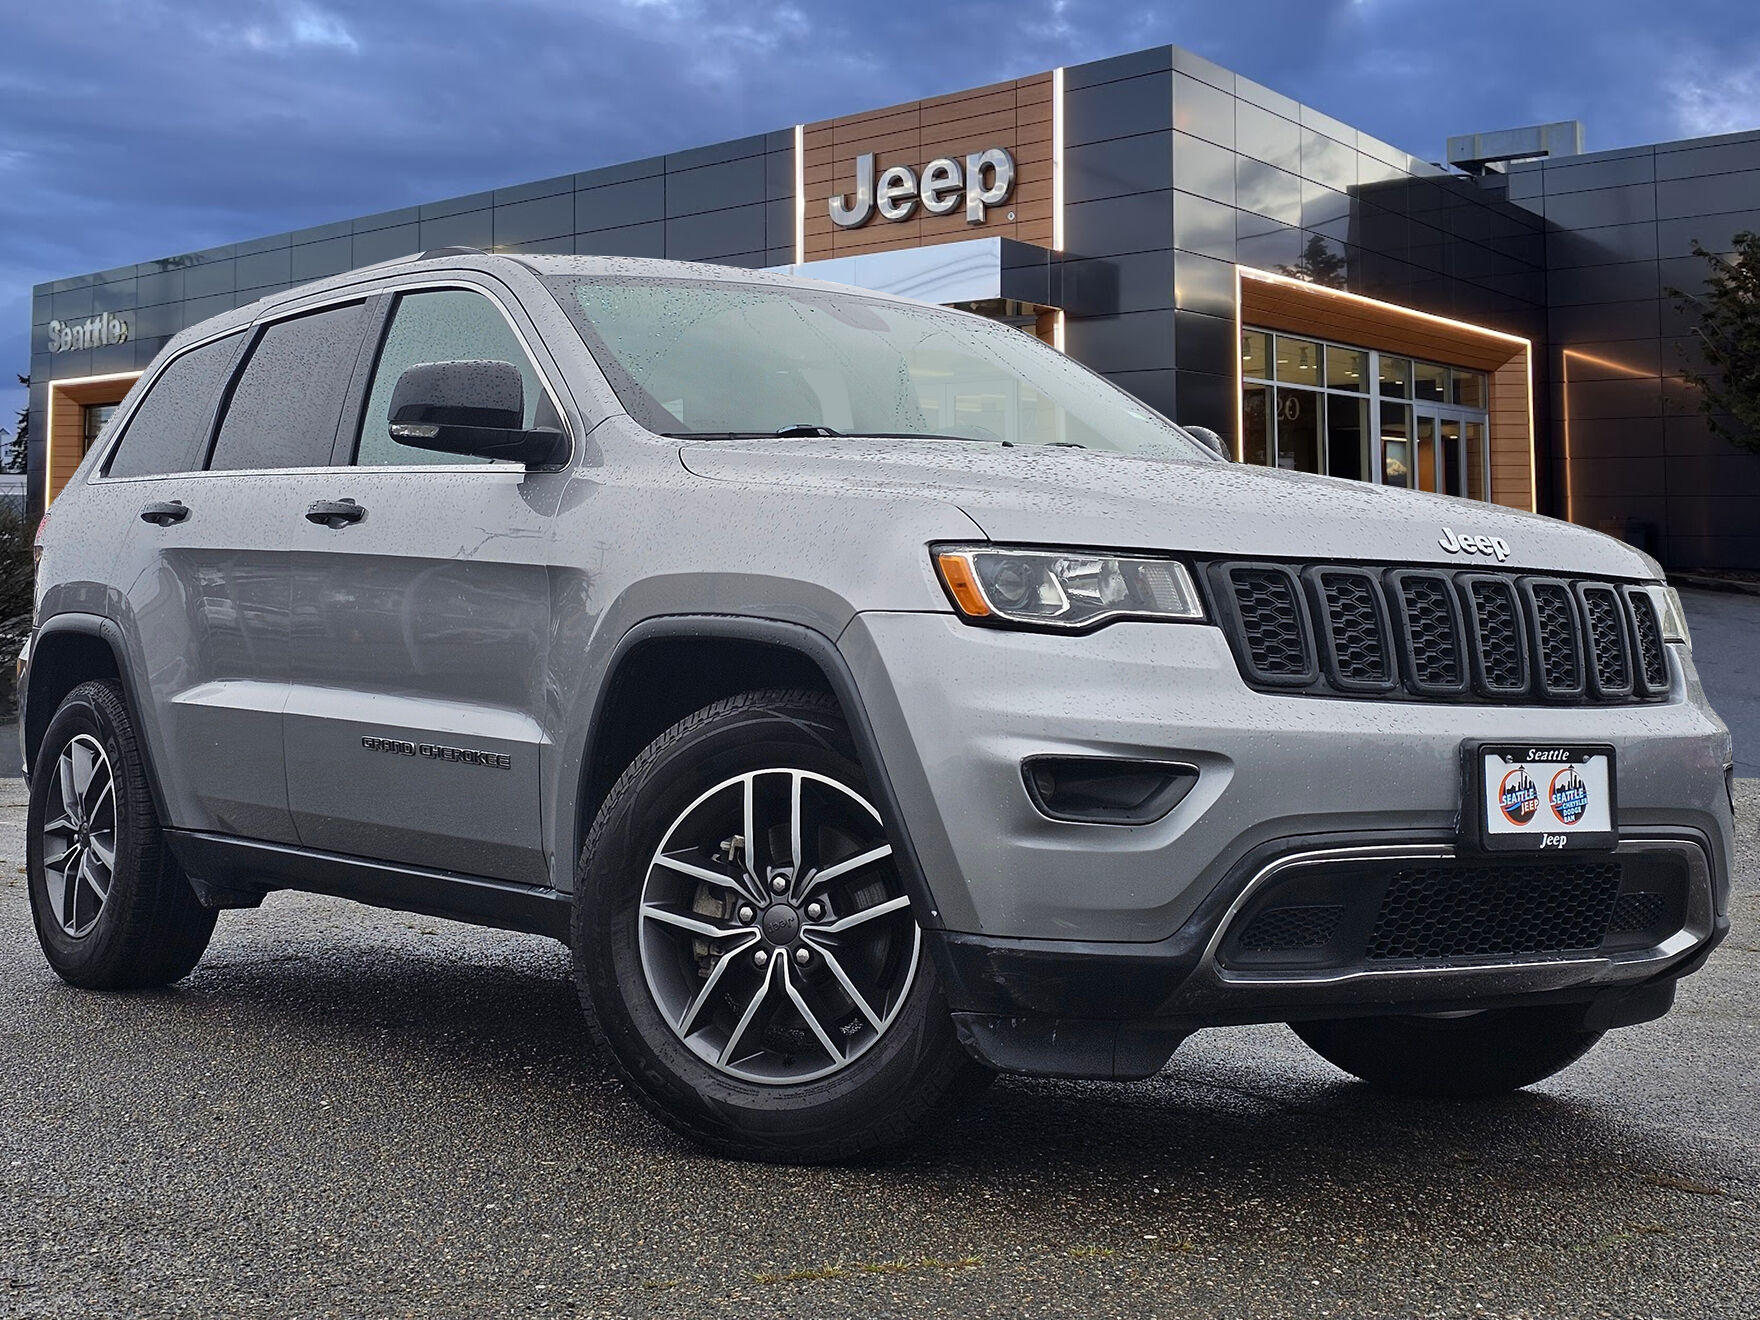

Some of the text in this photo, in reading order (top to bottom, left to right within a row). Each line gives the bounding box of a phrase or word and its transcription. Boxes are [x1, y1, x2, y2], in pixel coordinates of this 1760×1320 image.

[828, 147, 1016, 229] Jeep
[48, 312, 128, 353] Seattle
[1438, 527, 1511, 563] Jeep
[361, 736, 511, 769] GRAND CHEROKEE
[1526, 749, 1570, 761] Seattle
[1502, 788, 1534, 806] SEATTLE
[1551, 788, 1583, 805] SEATTLE
[1521, 799, 1539, 815] JEEP
[1540, 834, 1567, 848] Jeep
